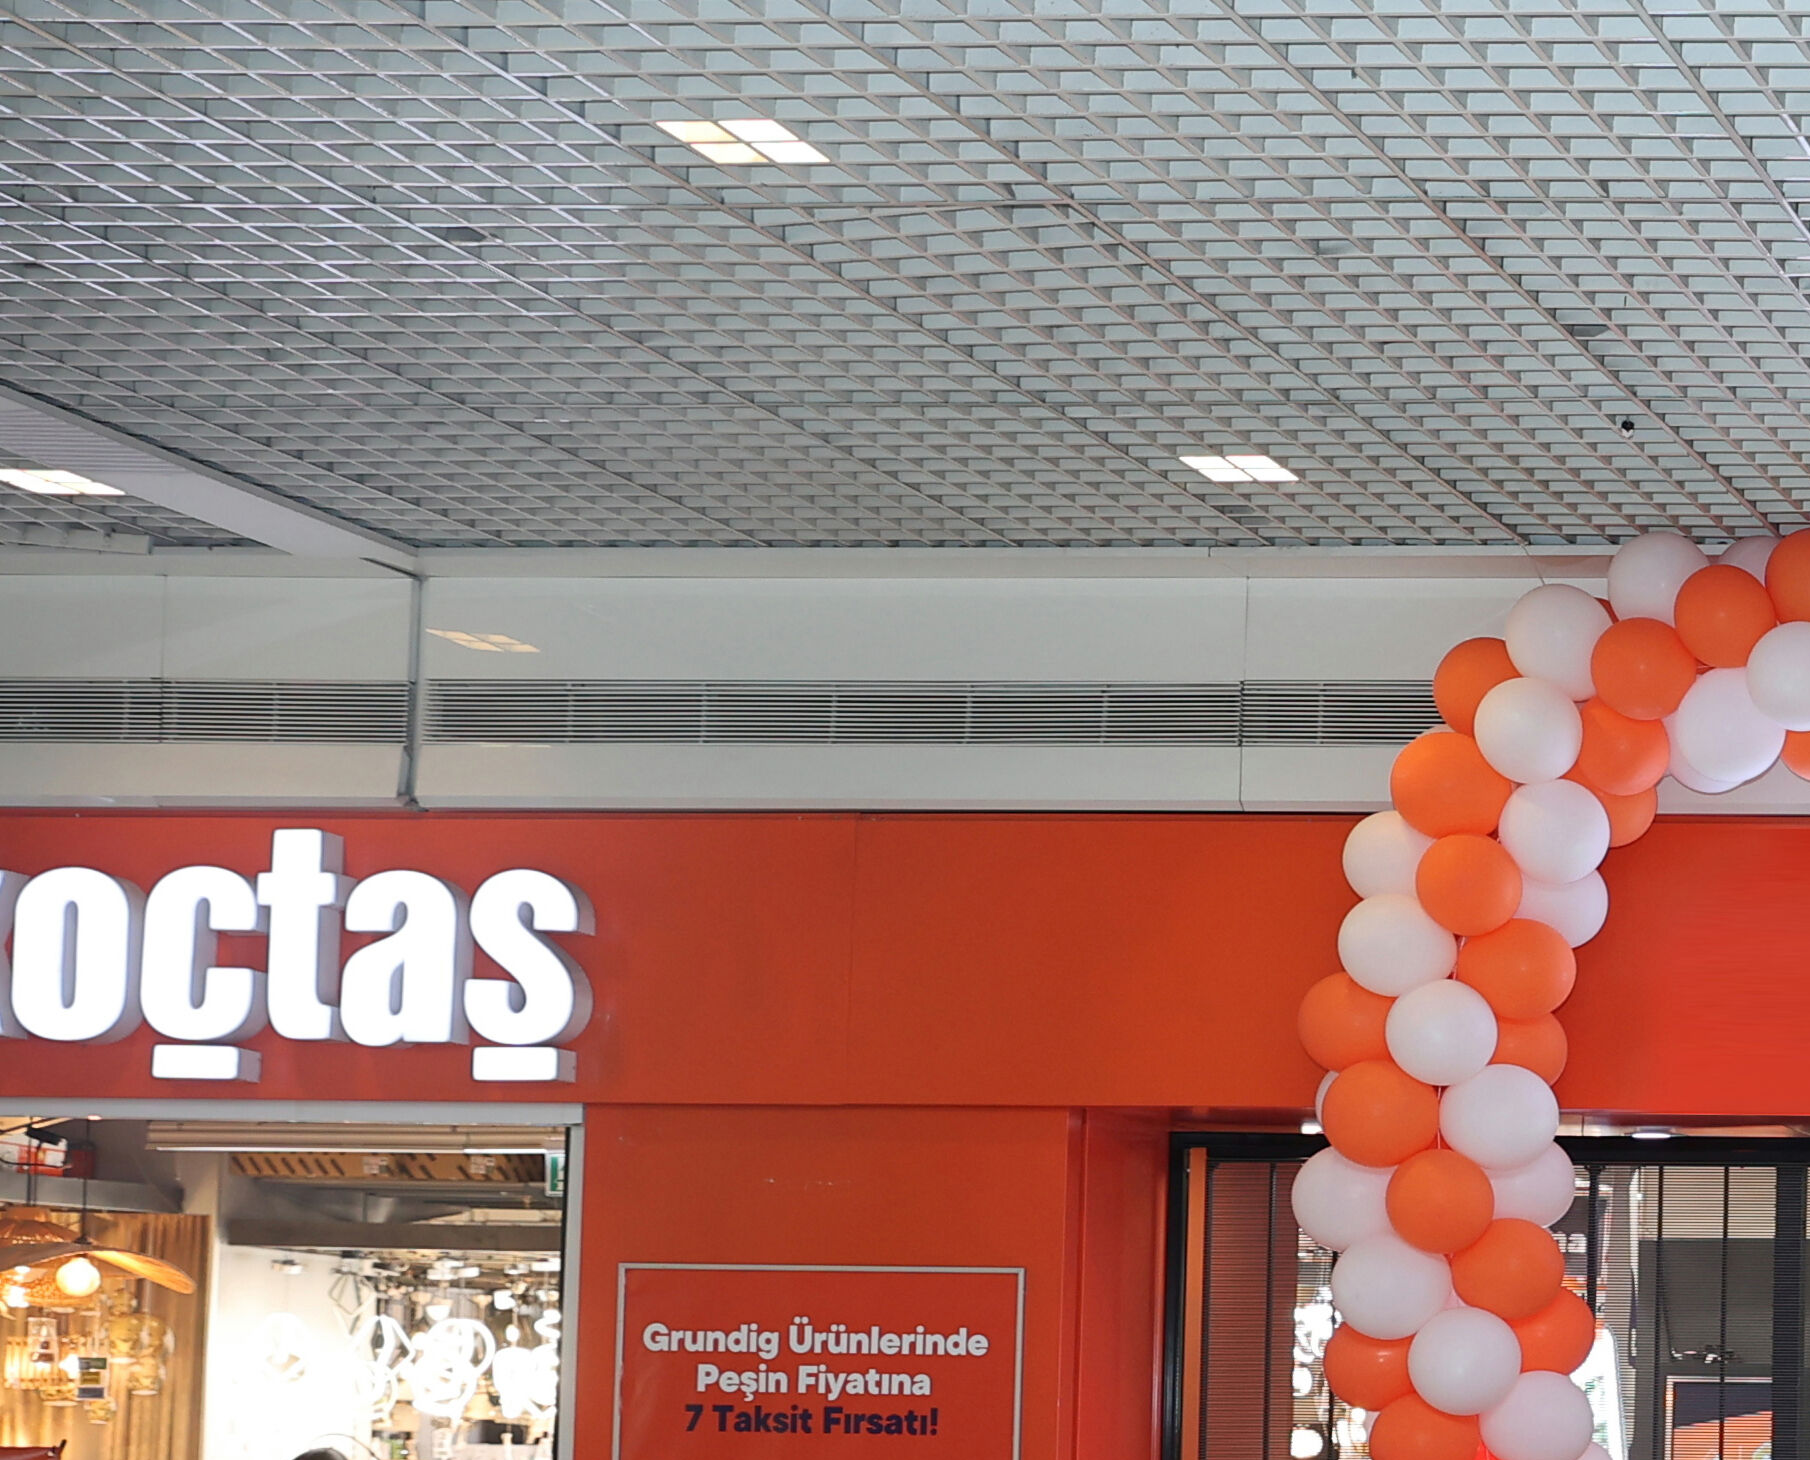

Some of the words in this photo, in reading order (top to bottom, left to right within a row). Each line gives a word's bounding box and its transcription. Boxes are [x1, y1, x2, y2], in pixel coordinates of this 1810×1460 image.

[0, 828, 596, 1083] oçtaş
[642, 1322, 780, 1360] Grundig
[788, 1316, 989, 1356] Ürünlerinde
[696, 1363, 788, 1402] Peşin
[798, 1363, 931, 1401] Fiyatına
[685, 1404, 704, 1431] 7
[712, 1405, 812, 1432] Taksit
[823, 1406, 938, 1435] Fırsatı!
